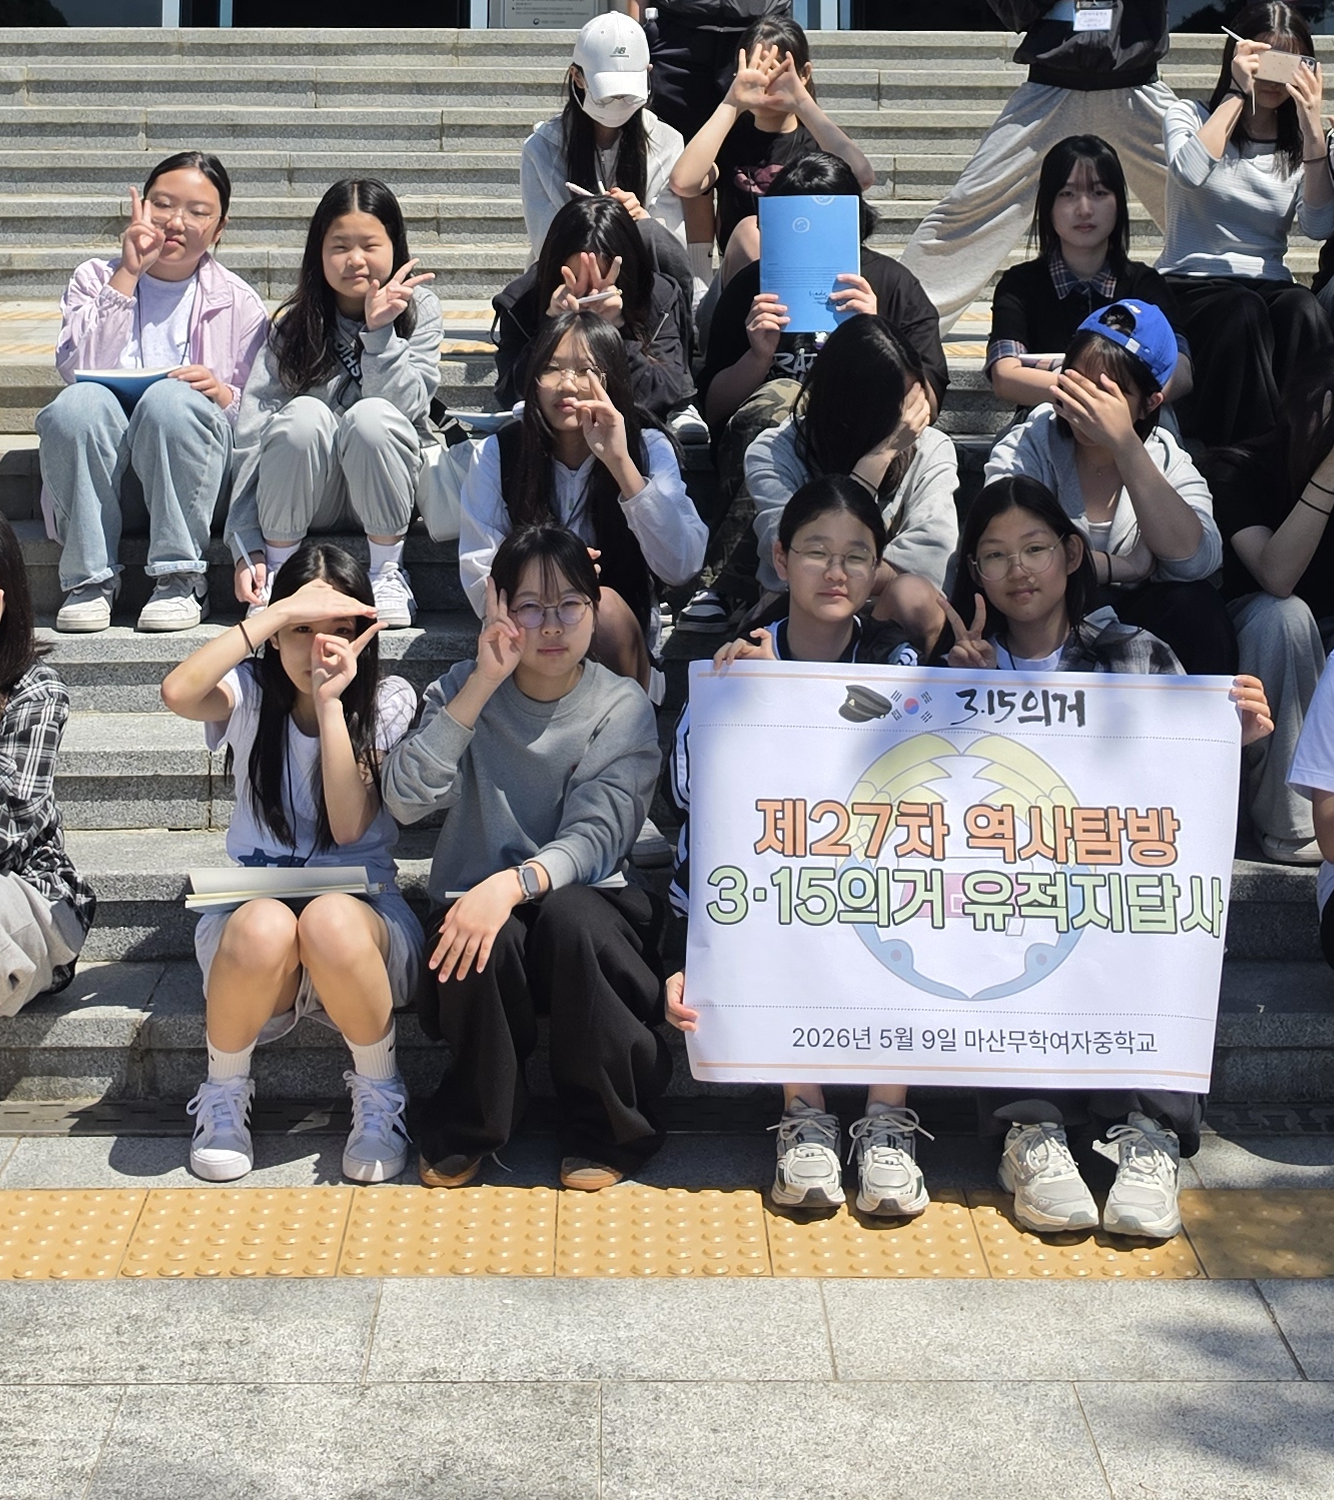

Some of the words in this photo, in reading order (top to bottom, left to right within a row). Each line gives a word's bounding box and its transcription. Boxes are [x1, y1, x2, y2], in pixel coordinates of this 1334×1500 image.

[950, 688, 1086, 728] 3.15의거
[753, 797, 951, 862] 제27차
[963, 803, 1181, 868] 역사탐방
[705, 864, 946, 930] 3·15의거
[961, 870, 1224, 939] 유적지답사
[792, 1026, 871, 1050] 2026년
[879, 1027, 914, 1051] 5월
[921, 1028, 957, 1052] 9일
[964, 1028, 1158, 1055] 마산무학여자중학교
